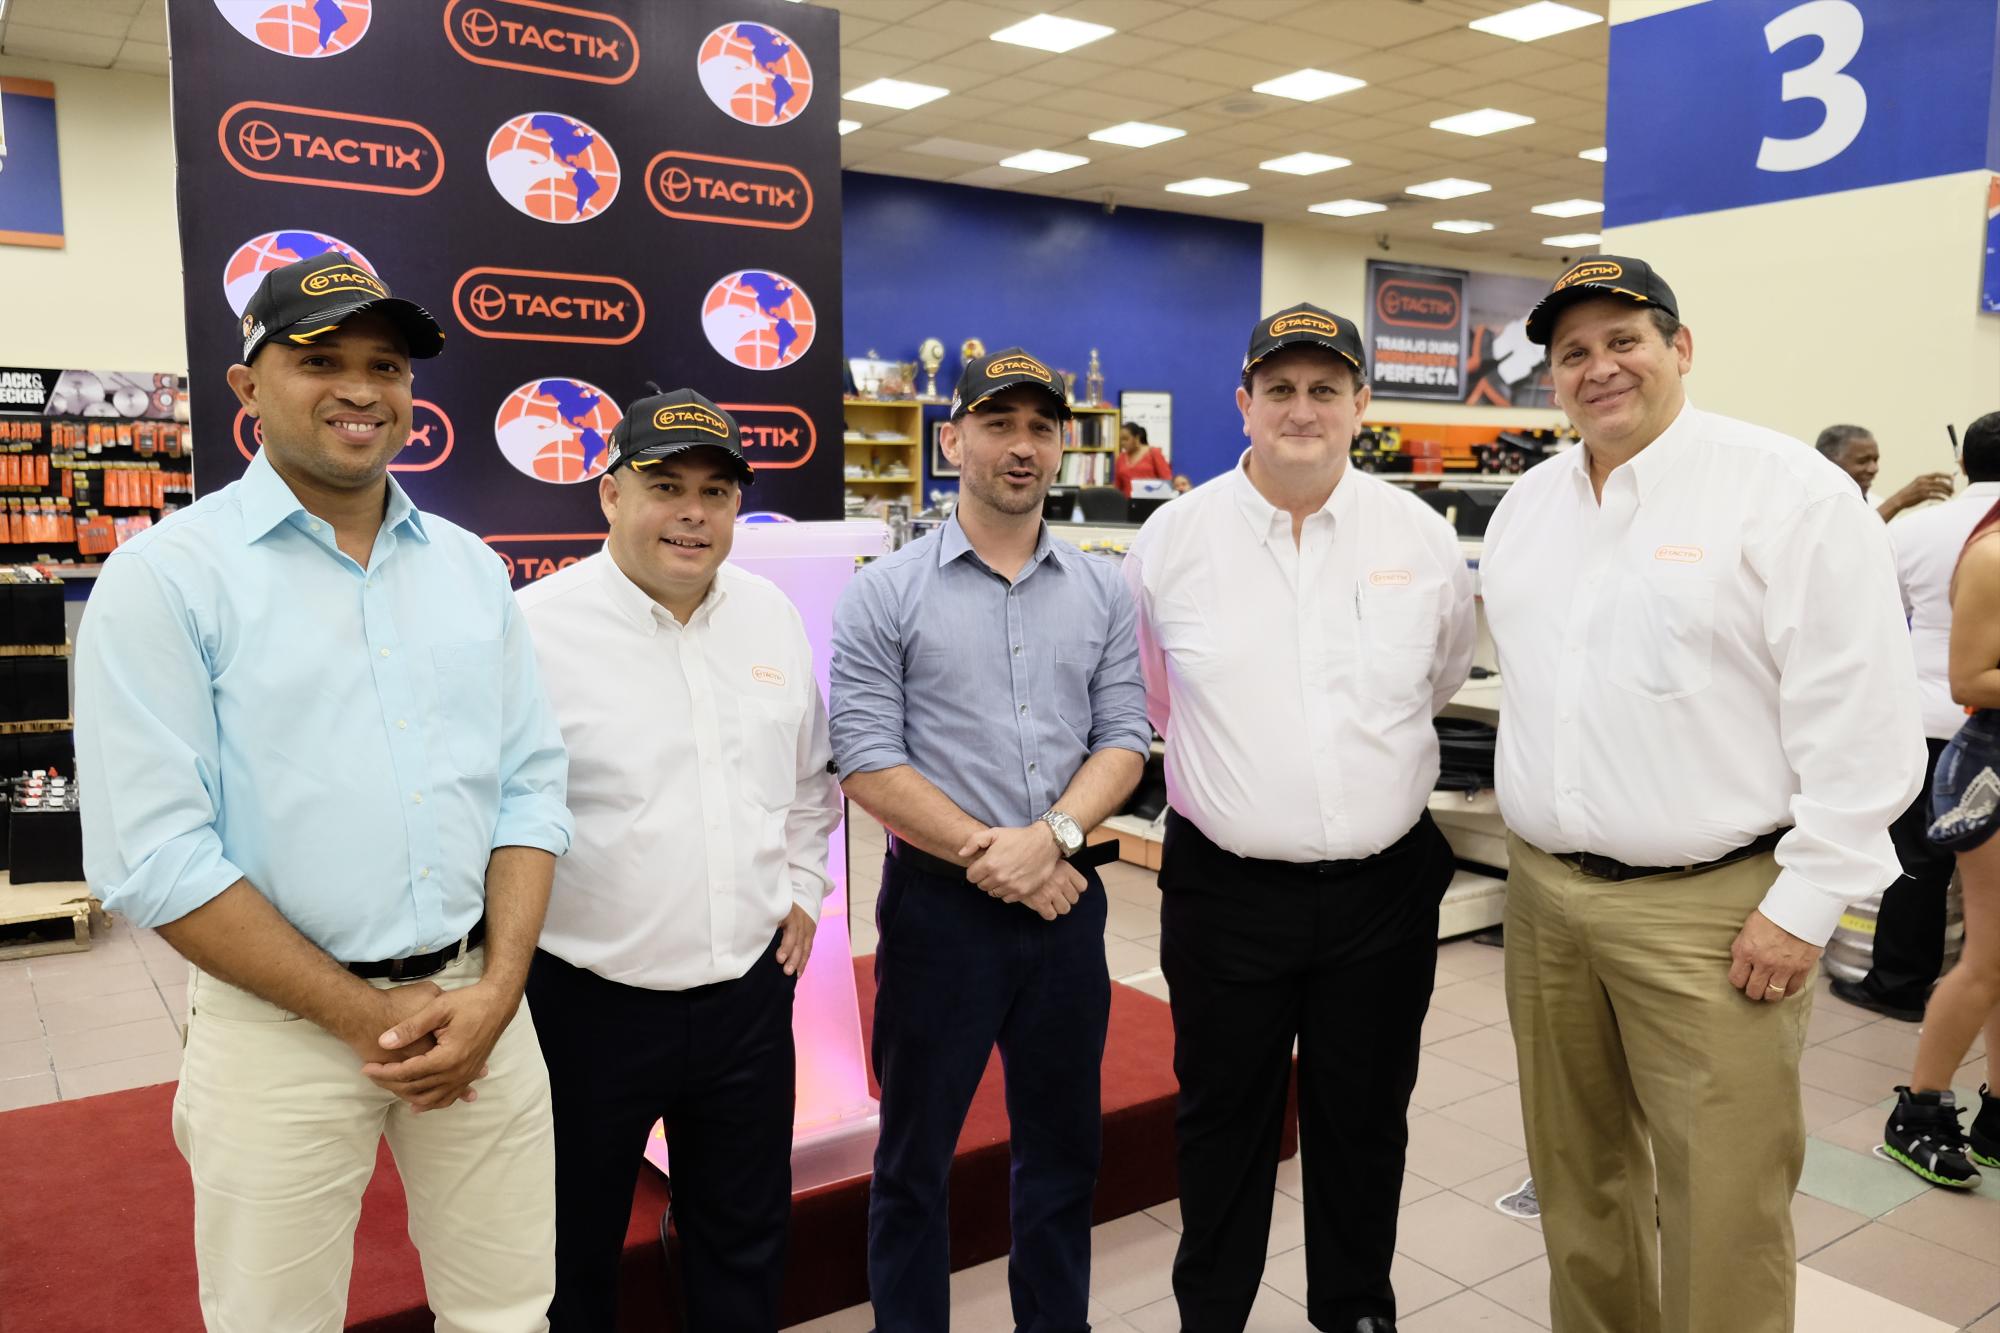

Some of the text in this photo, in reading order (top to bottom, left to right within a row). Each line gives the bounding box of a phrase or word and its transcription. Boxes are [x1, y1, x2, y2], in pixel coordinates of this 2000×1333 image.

[500, 20, 620, 62] TACTIX
[1756, 0, 1867, 172] 3
[284, 132, 421, 171] TACTIX
[693, 177, 796, 209] TACTIX
[508, 293, 625, 322] TACTIX
[1287, 319, 1331, 331] TACTIX
[1374, 363, 1458, 386] PERFECTA
[674, 412, 723, 430] TACTIX
[740, 426, 799, 447] CTIX
